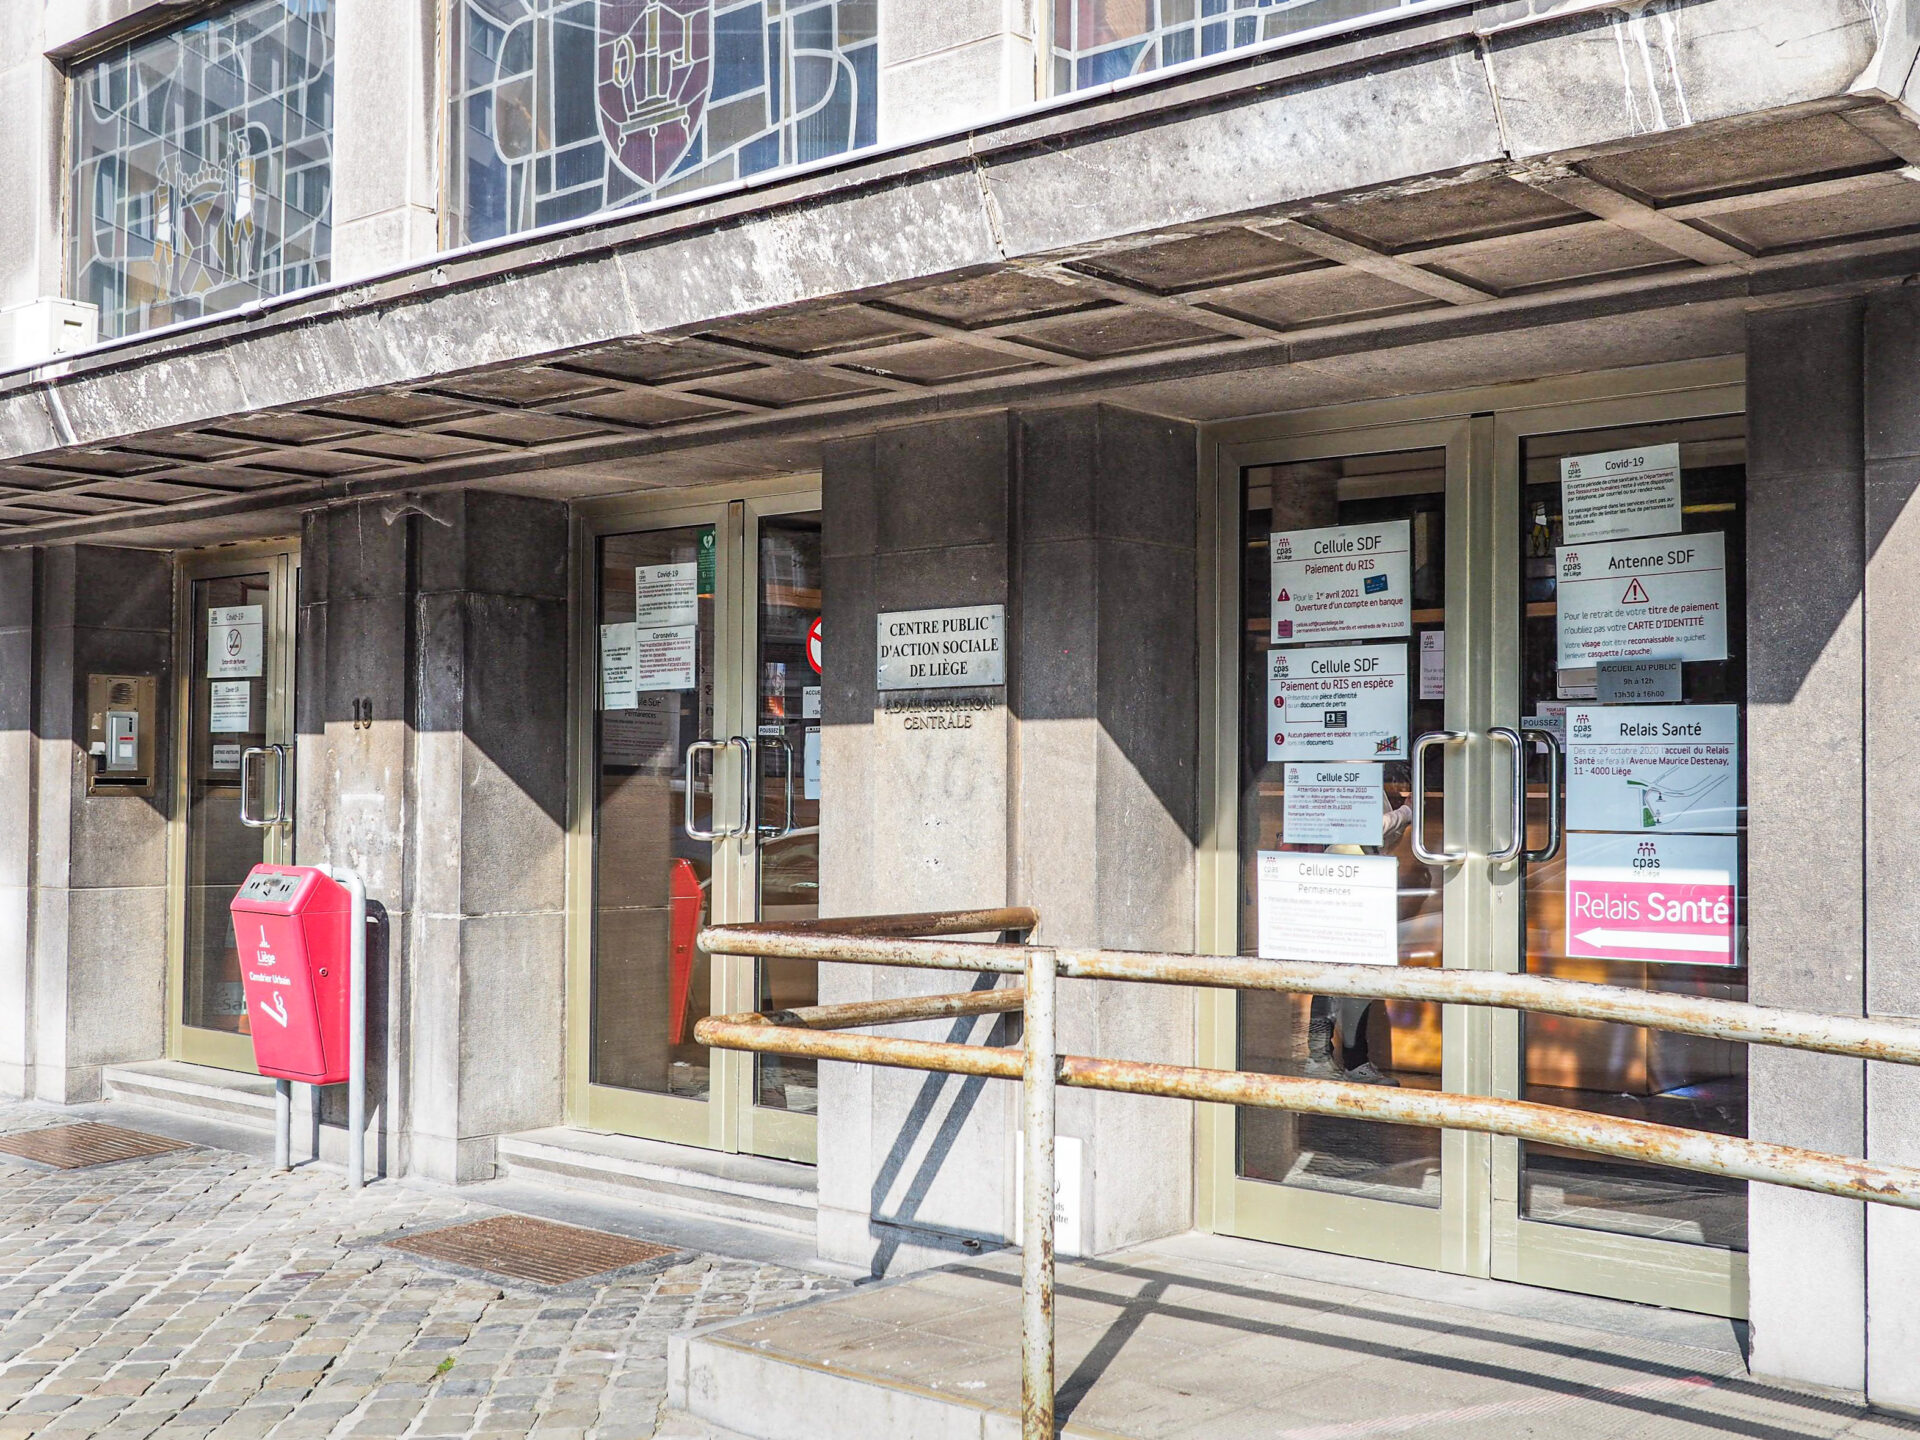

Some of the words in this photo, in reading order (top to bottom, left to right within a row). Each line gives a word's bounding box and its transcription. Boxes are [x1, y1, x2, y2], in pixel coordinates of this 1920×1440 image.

[1606, 457, 1644, 470] Covid-19
[1277, 547, 1292, 556] cpas
[1314, 539, 1353, 554] Cellule
[1357, 536, 1382, 550] SDF
[1305, 562, 1343, 574] Paiement
[1346, 561, 1356, 571] du
[1358, 559, 1374, 570] RIS
[1609, 556, 1663, 570] Antenne
[1668, 549, 1695, 564] SDF
[657, 570, 678, 578] Covid-19
[1563, 563, 1581, 572] cpas
[1326, 590, 1340, 599] avril
[1341, 589, 1359, 598] 2021
[1295, 602, 1327, 612] Ouverture
[1329, 602, 1342, 610] d'un
[1344, 600, 1368, 609] compte
[1379, 598, 1403, 606] banque
[1564, 612, 1580, 620] Pour
[1582, 611, 1588, 619] le
[1590, 610, 1613, 619] retrait
[1648, 605, 1667, 614] titre
[1669, 605, 1679, 613] de
[1681, 602, 1719, 613] paiement
[890, 621, 939, 636] CENTRE
[943, 617, 988, 633] PUBLIC
[1564, 626, 1592, 634] n'oubliez
[1628, 621, 1654, 630] CARTE
[1656, 616, 1704, 629] D'IDENTITÉ
[881, 641, 940, 658] D'ACTION
[943, 638, 999, 655] SOCIALE
[1582, 640, 1600, 648] visage
[1628, 636, 1674, 644] reconnaissable
[1684, 634, 1705, 643] guichet
[1565, 651, 1585, 659] (enlever
[1588, 650, 1618, 659] casquette
[1625, 648, 1652, 656] capuche)
[910, 663, 926, 677] DE
[930, 659, 968, 676] LIÈGE
[1312, 660, 1350, 674] Cellule
[1354, 658, 1379, 672] SDF
[1281, 681, 1318, 691] Paiement
[1321, 680, 1331, 690] du
[1333, 679, 1349, 689] RIS
[1352, 680, 1361, 688] en
[1364, 678, 1394, 690] espèce
[885, 696, 993, 714] ADMINISTRATION
[625, 710, 656, 719] Permanences
[904, 715, 973, 730] CENTRALE
[1574, 725, 1592, 733] cpas
[1620, 723, 1658, 736] Relais
[1662, 722, 1702, 736] Santé
[1574, 746, 1586, 755] Dès
[1694, 746, 1703, 755] du
[1706, 746, 1729, 755] Relais
[1691, 757, 1729, 766] Destenay,
[1317, 773, 1342, 782] Cellule
[1344, 773, 1360, 782] SDF
[1612, 767, 1631, 776] Liège
[1299, 863, 1334, 877] Cellule
[1337, 865, 1359, 878] SDF
[1633, 858, 1660, 870] cpas
[1298, 884, 1351, 895] Permanences
[1575, 891, 1640, 920] Relais
[1648, 892, 1729, 924] Santé
[257, 950, 276, 965] Liège
[272, 974, 291, 986] Urbain
